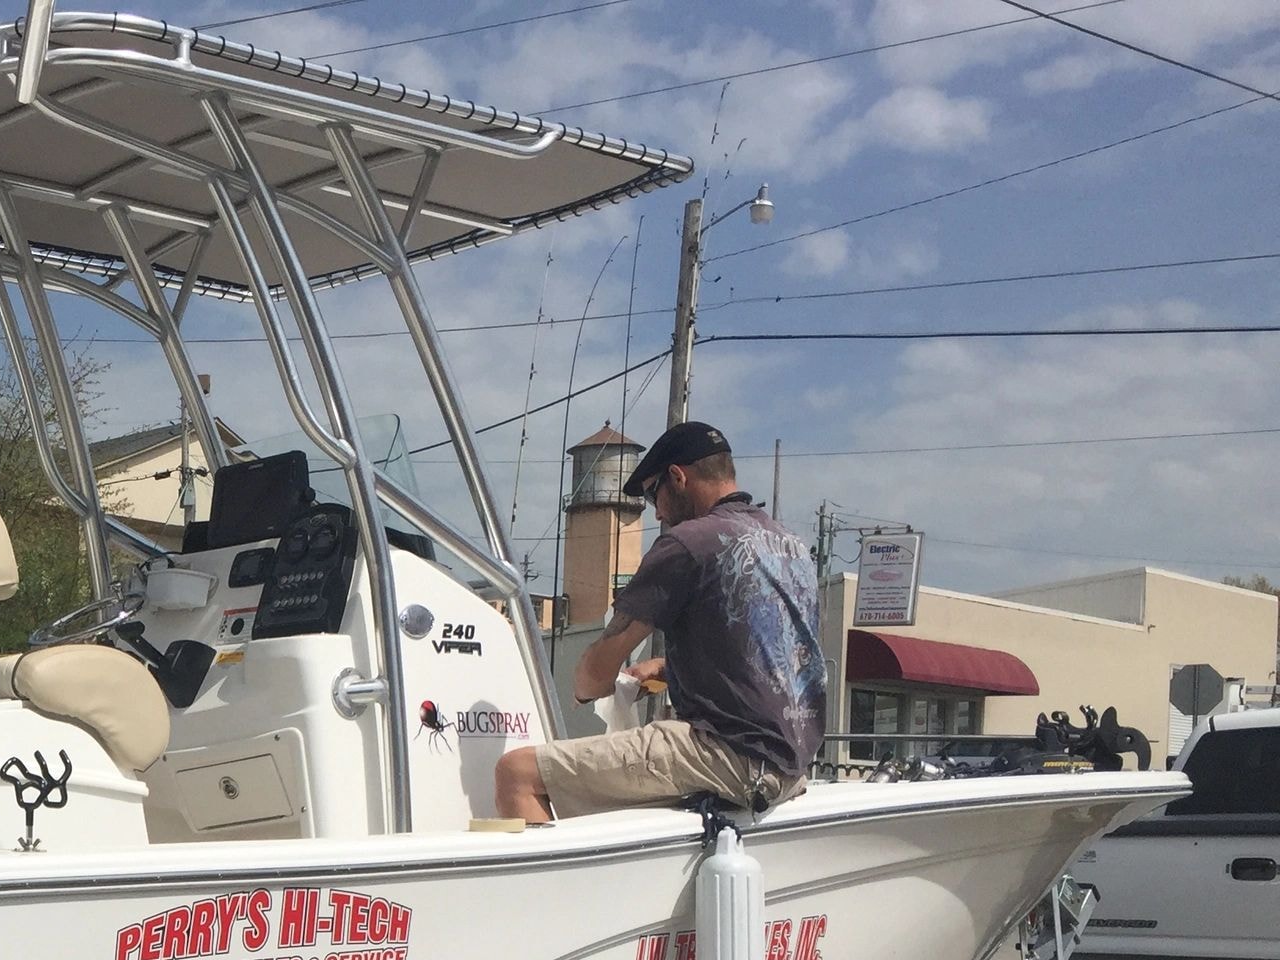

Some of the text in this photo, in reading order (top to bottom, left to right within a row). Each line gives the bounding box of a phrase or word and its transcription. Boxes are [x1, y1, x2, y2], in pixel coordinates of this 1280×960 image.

[442, 623, 475, 640] 240
[432, 640, 482, 656] VIPER
[456, 711, 530, 734] BUGSPRAY
[278, 887, 412, 948] HI-TECH
